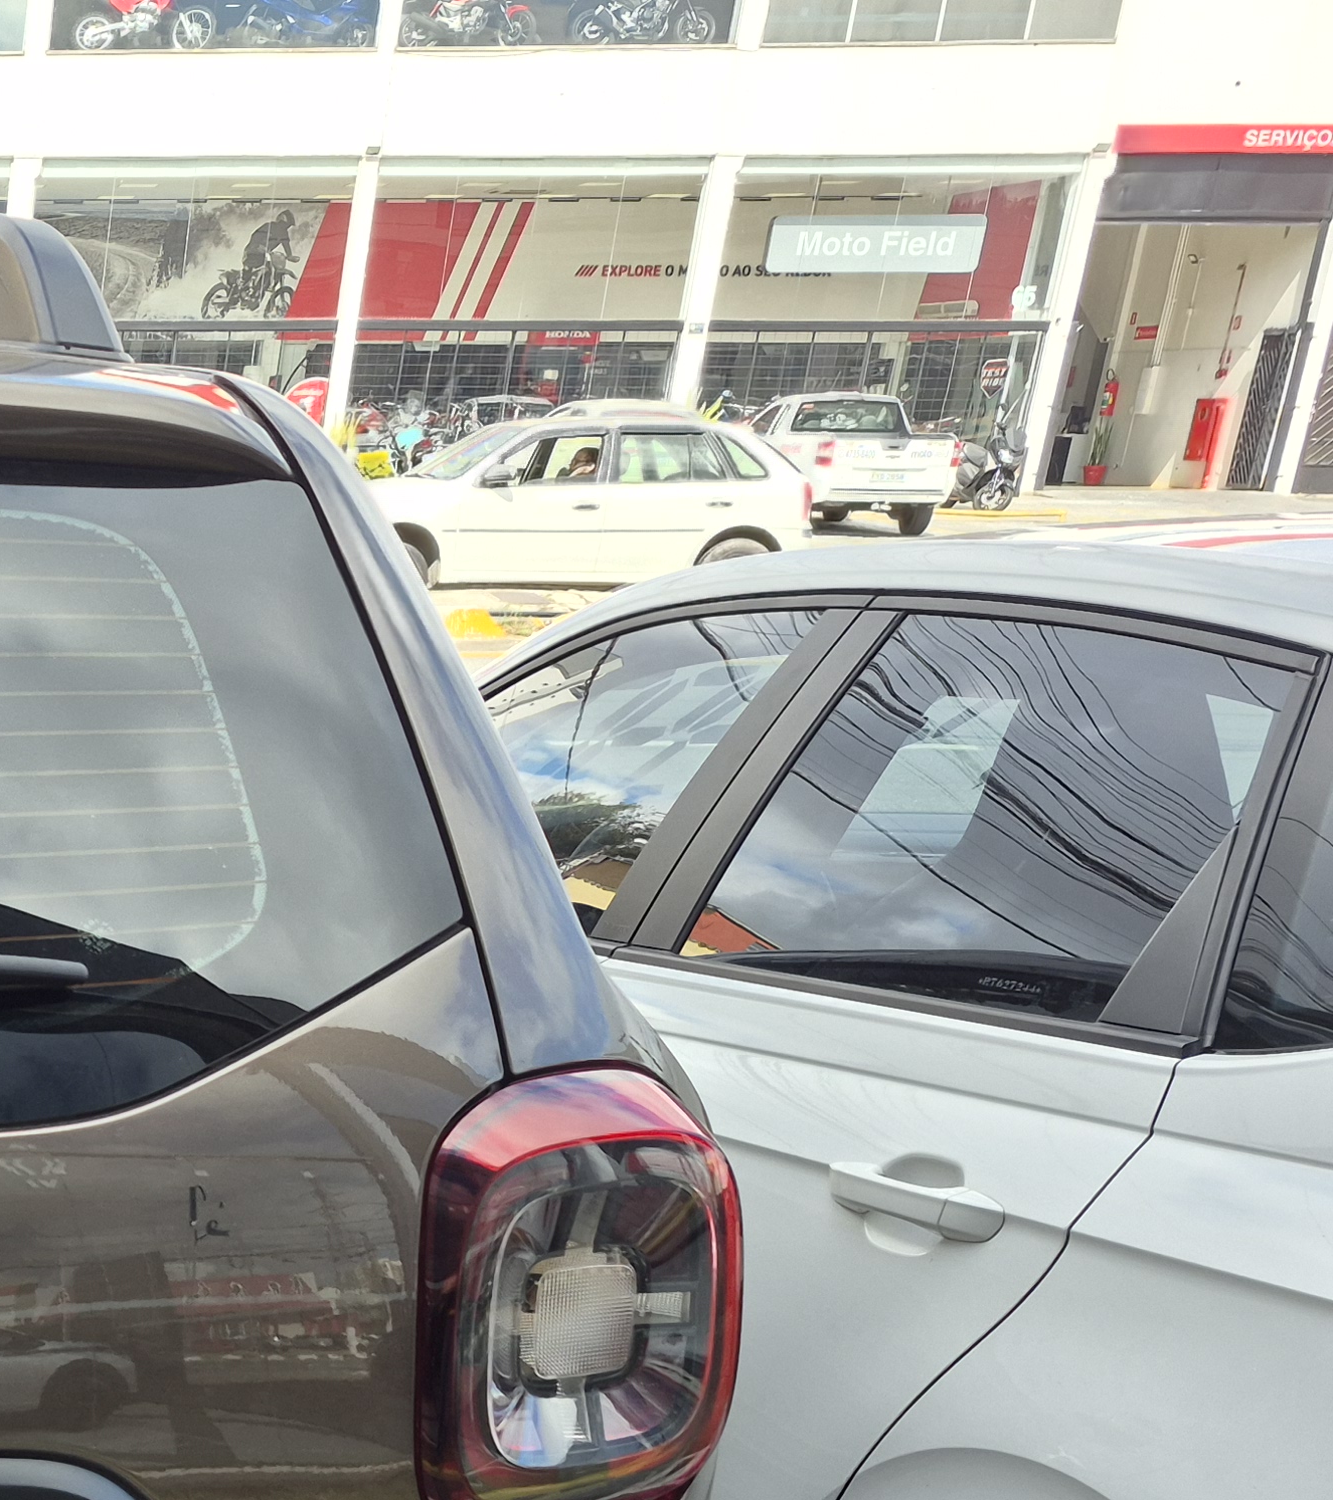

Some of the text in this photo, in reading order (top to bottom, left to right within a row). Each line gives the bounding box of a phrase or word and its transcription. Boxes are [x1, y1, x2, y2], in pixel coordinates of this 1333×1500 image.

[1243, 129, 1333, 151] SERVIÇO
[796, 230, 956, 256] Moto Field
[601, 264, 662, 278] EXPLORE
[664, 264, 675, 278] O
[731, 264, 751, 278] AO
[1012, 285, 1037, 308] 65
[544, 331, 591, 339] HONDA
